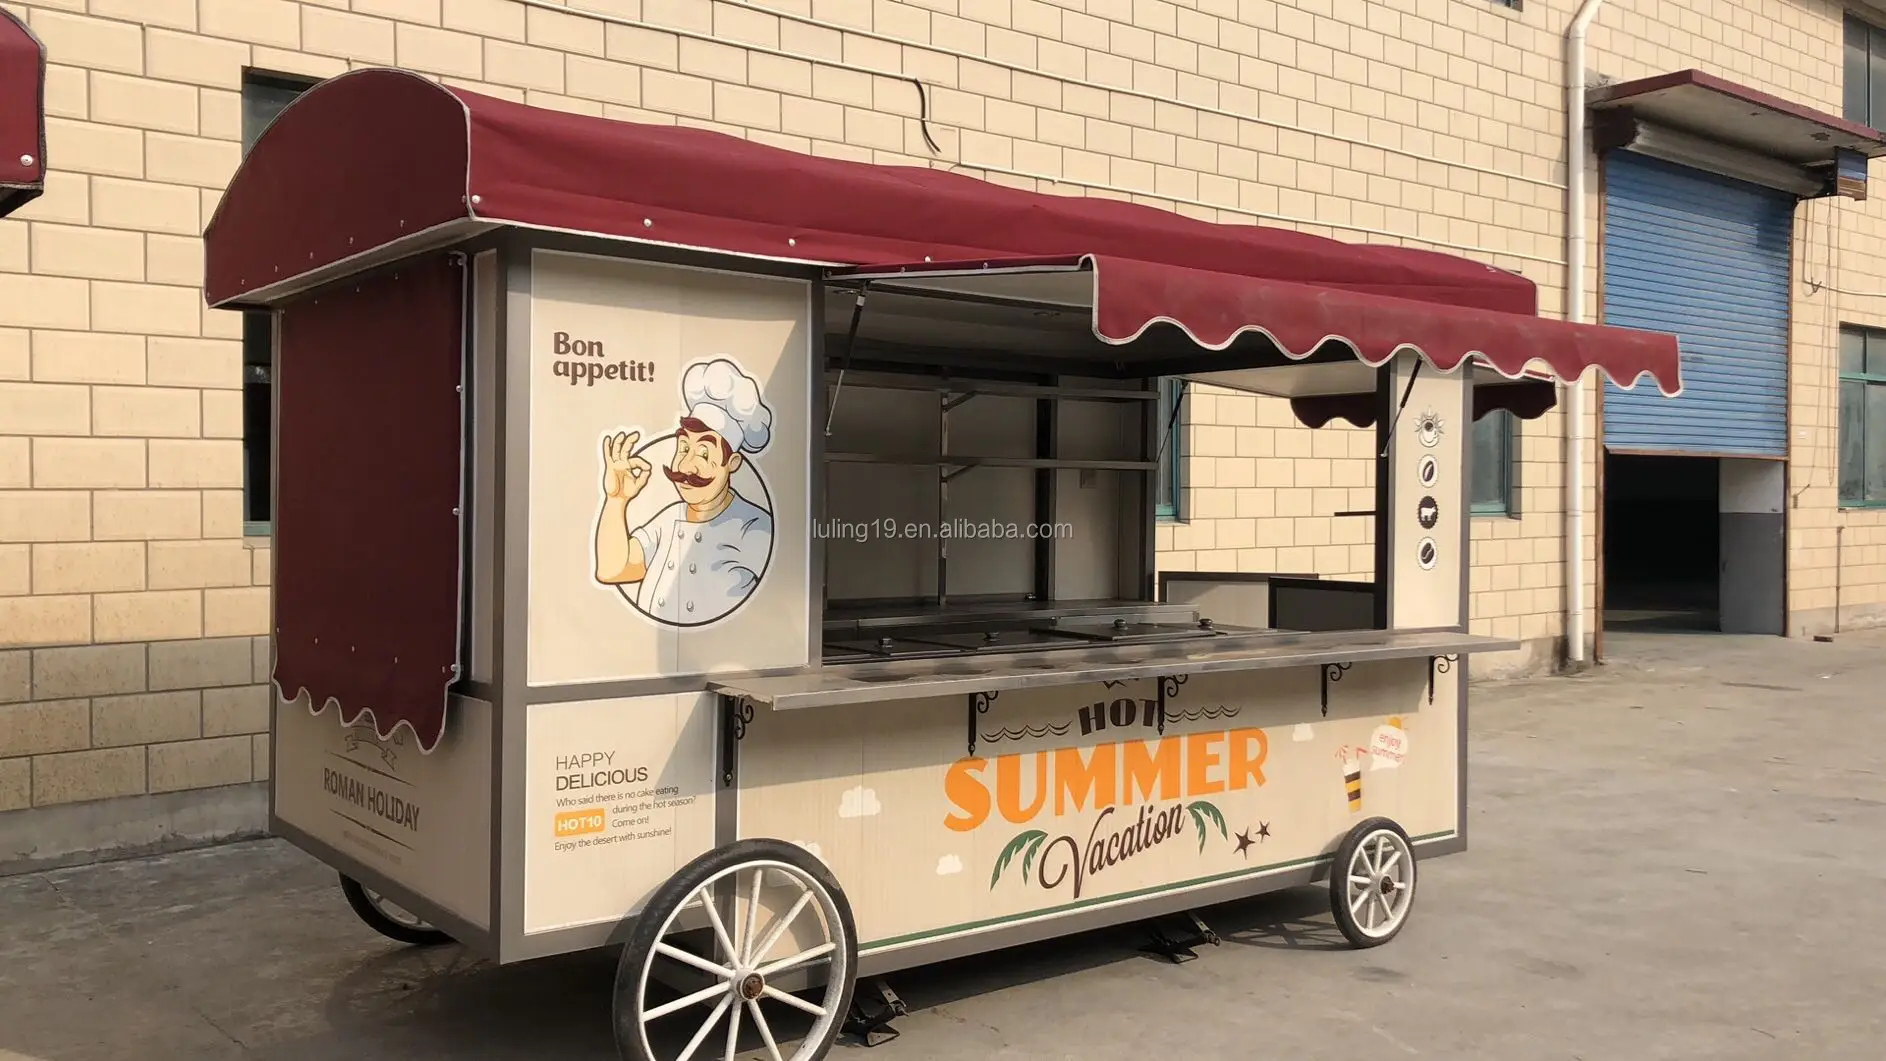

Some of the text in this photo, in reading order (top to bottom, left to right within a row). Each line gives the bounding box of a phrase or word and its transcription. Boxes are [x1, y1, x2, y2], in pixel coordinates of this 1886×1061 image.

[553, 331, 605, 358] Bon
[552, 360, 655, 387] appetit!
[1078, 698, 1159, 736] HOT
[556, 750, 616, 770] HAPPY
[555, 766, 649, 792] DELICIOUS
[944, 727, 1268, 832] SUMMER
[324, 768, 420, 832] ROMAN HOLIDAY
[556, 785, 679, 808] Who said there is no cake eating
[612, 796, 697, 815] during the hot season?
[557, 814, 602, 833] HOT10
[612, 815, 650, 829] Come on!
[554, 827, 672, 853] Enjoy the desert with sunshine!
[1038, 802, 1187, 899] Vacation
